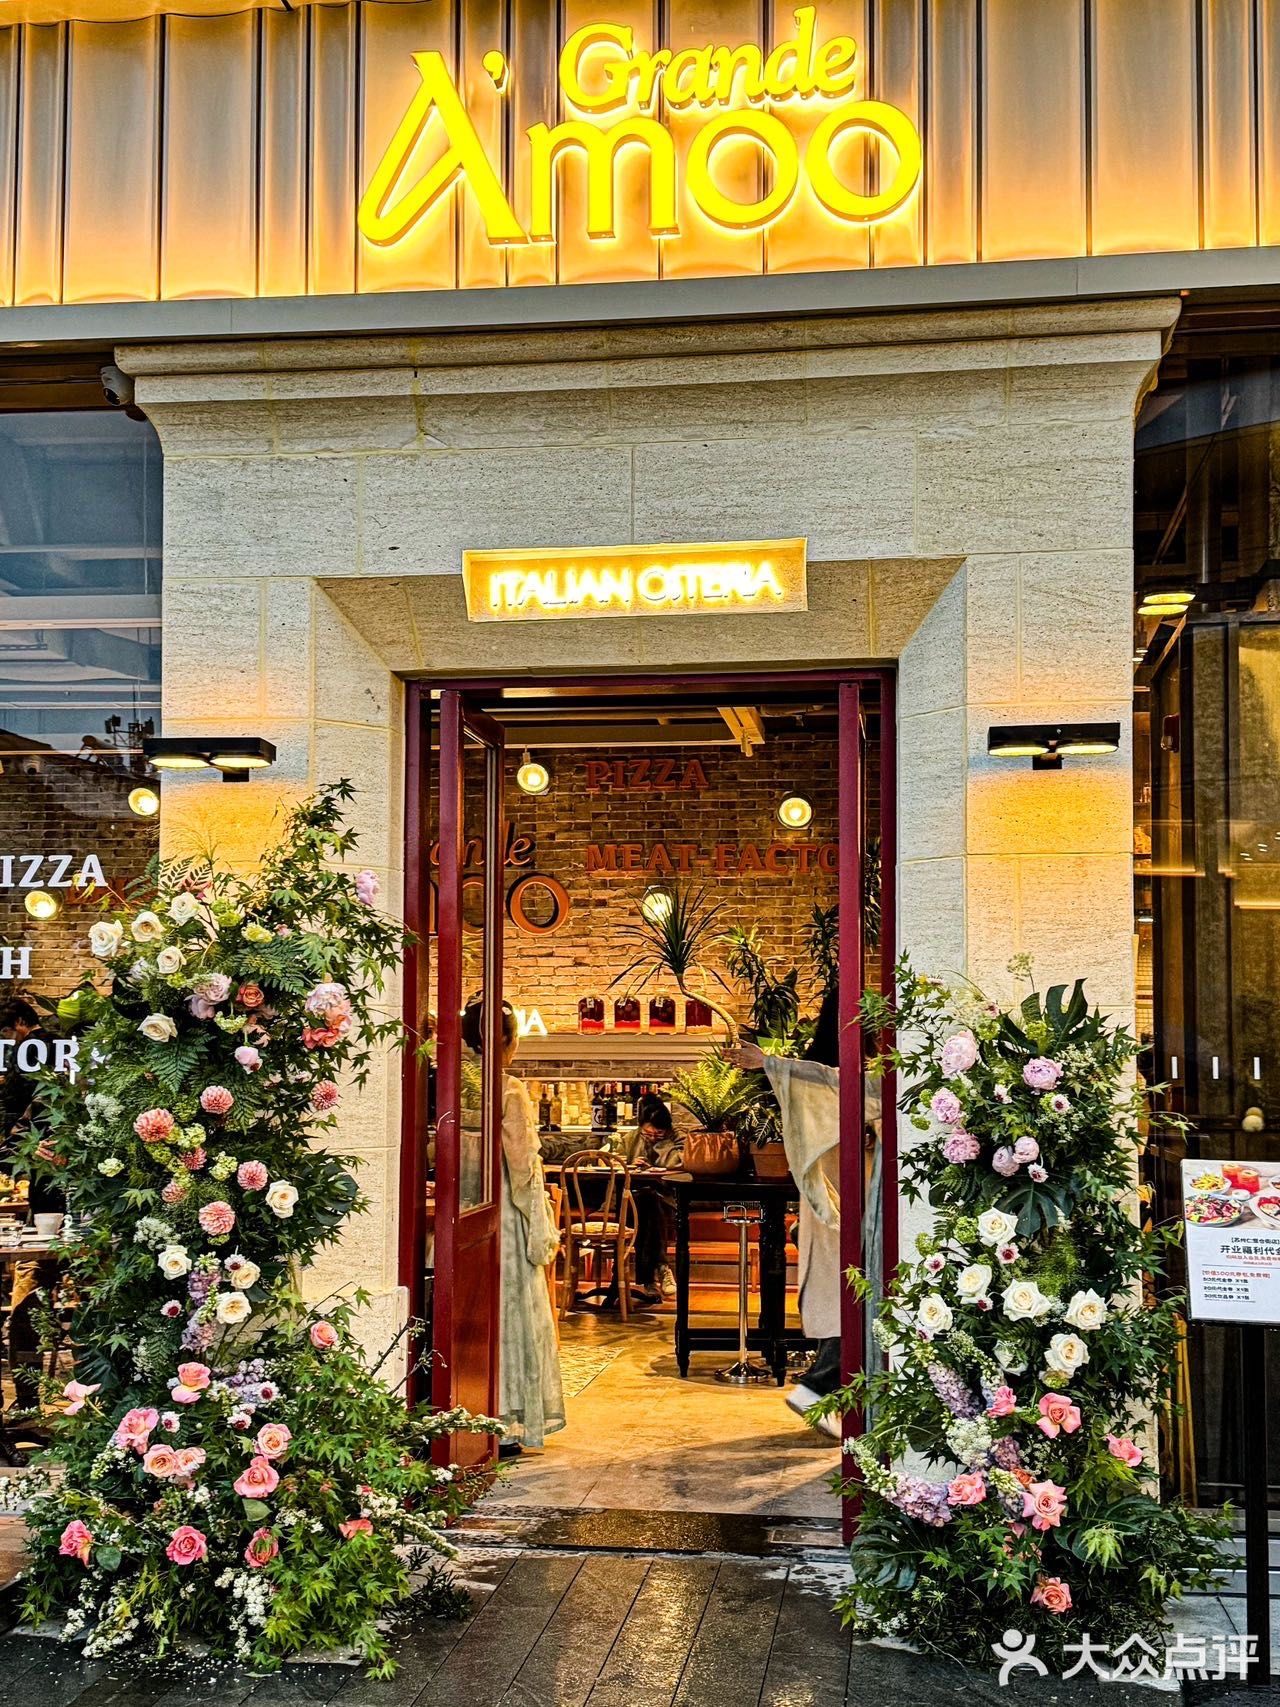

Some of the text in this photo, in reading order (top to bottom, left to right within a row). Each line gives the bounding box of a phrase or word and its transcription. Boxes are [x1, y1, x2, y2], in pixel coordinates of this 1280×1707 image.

[560, 6, 857, 112] Grande
[490, 560, 785, 606] ITALIAN OSTERIA
[585, 759, 709, 790] PIZZA
